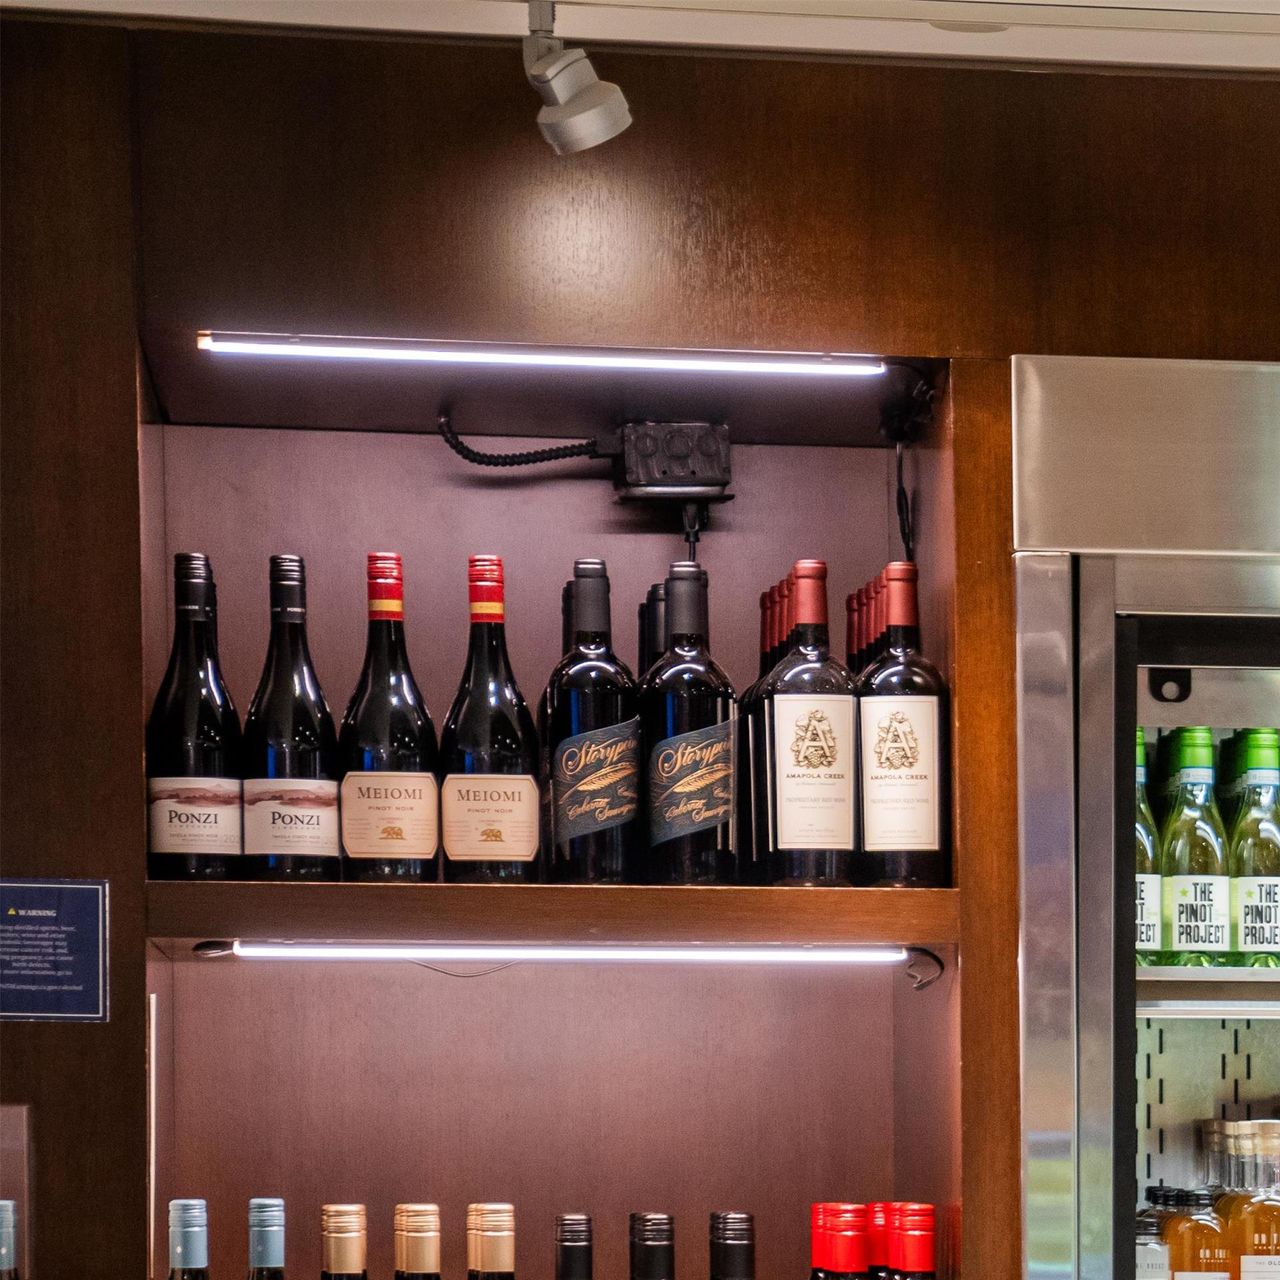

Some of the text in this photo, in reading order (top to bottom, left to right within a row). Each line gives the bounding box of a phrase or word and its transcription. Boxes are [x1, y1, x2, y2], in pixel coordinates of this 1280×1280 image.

[357, 787, 423, 800] MEIOMI
[457, 789, 522, 802] MEIOMI
[168, 809, 219, 824] PONZI
[271, 811, 321, 825] PONZI
[1192, 882, 1213, 902] THE
[1257, 883, 1279, 903] THE
[1178, 903, 1213, 923] PINOT
[1244, 904, 1278, 924] PINOT
[1178, 924, 1225, 944] PROJECT
